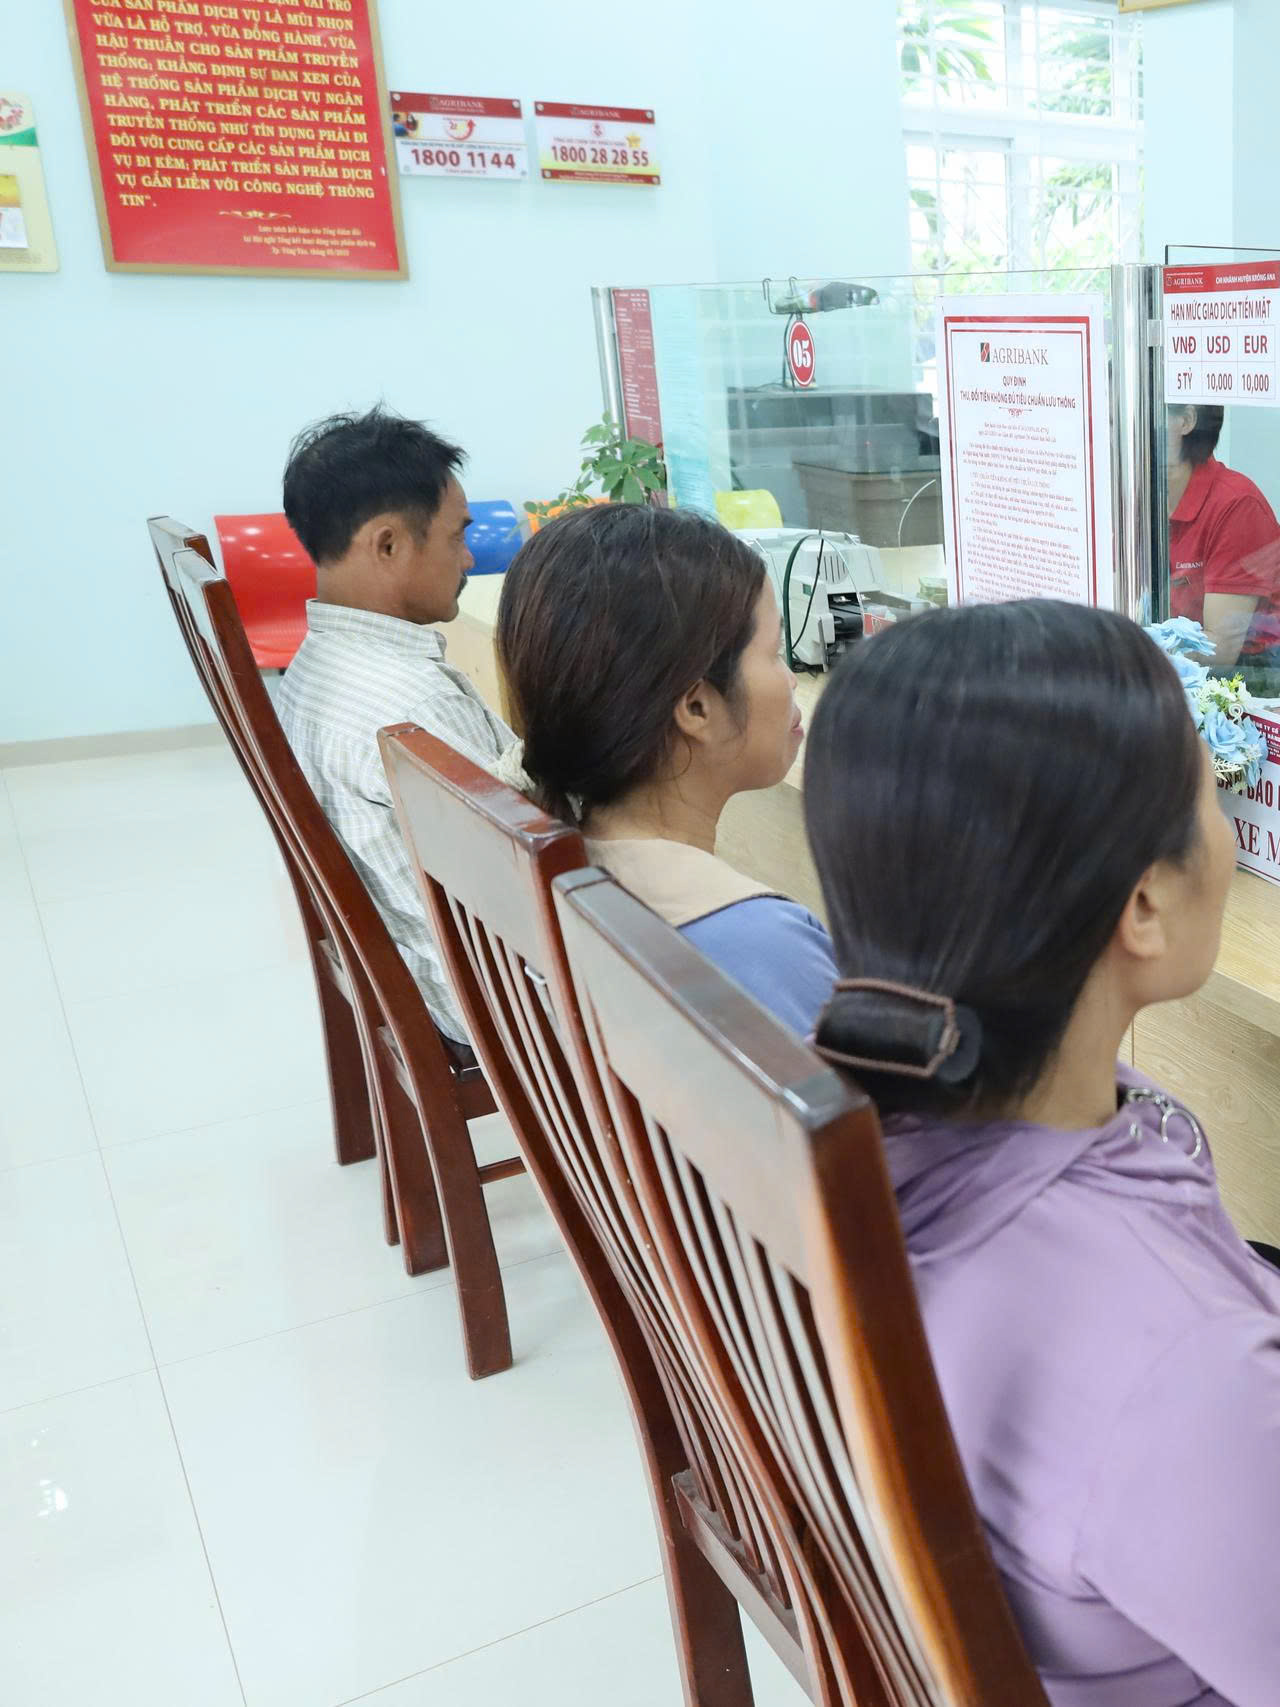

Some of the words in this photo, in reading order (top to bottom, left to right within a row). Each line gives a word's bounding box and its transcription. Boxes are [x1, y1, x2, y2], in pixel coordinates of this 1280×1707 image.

[203, 4, 239, 19] DỊCH
[242, 7, 260, 21] VỤ
[265, 9, 283, 24] LÀ
[317, 16, 353, 32] NHỌN
[189, 42, 220, 56] CHO
[224, 43, 253, 59] SẢN
[257, 46, 299, 63] PHẨM
[302, 51, 359, 68] TRUYỀN
[127, 74, 180, 91] THỐNG
[184, 78, 213, 94] SẢN
[217, 80, 259, 97] PHẨM
[263, 87, 299, 102] DỊCH
[302, 90, 320, 104] VỤ
[411, 148, 460, 167] 1800
[551, 145, 587, 162] 1800
[590, 148, 608, 164] 28
[612, 149, 628, 166] 28
[632, 151, 649, 167] 55
[115, 174, 136, 188] VỤ
[243, 179, 282, 193] CÔNG
[1202, 301, 1219, 321] GIAO
[1220, 301, 1236, 325] DỊCH
[793, 339, 811, 368] 05
[1172, 335, 1197, 354] VNĐ
[1206, 335, 1231, 354] USD
[1244, 335, 1268, 354] EUR
[992, 347, 1049, 366] AGRIBANK
[1003, 376, 1013, 387] QUY
[1177, 373, 1182, 390] 5
[1206, 373, 1232, 392] 10,000
[1242, 373, 1269, 394] 10,000
[1234, 816, 1260, 857] XE
